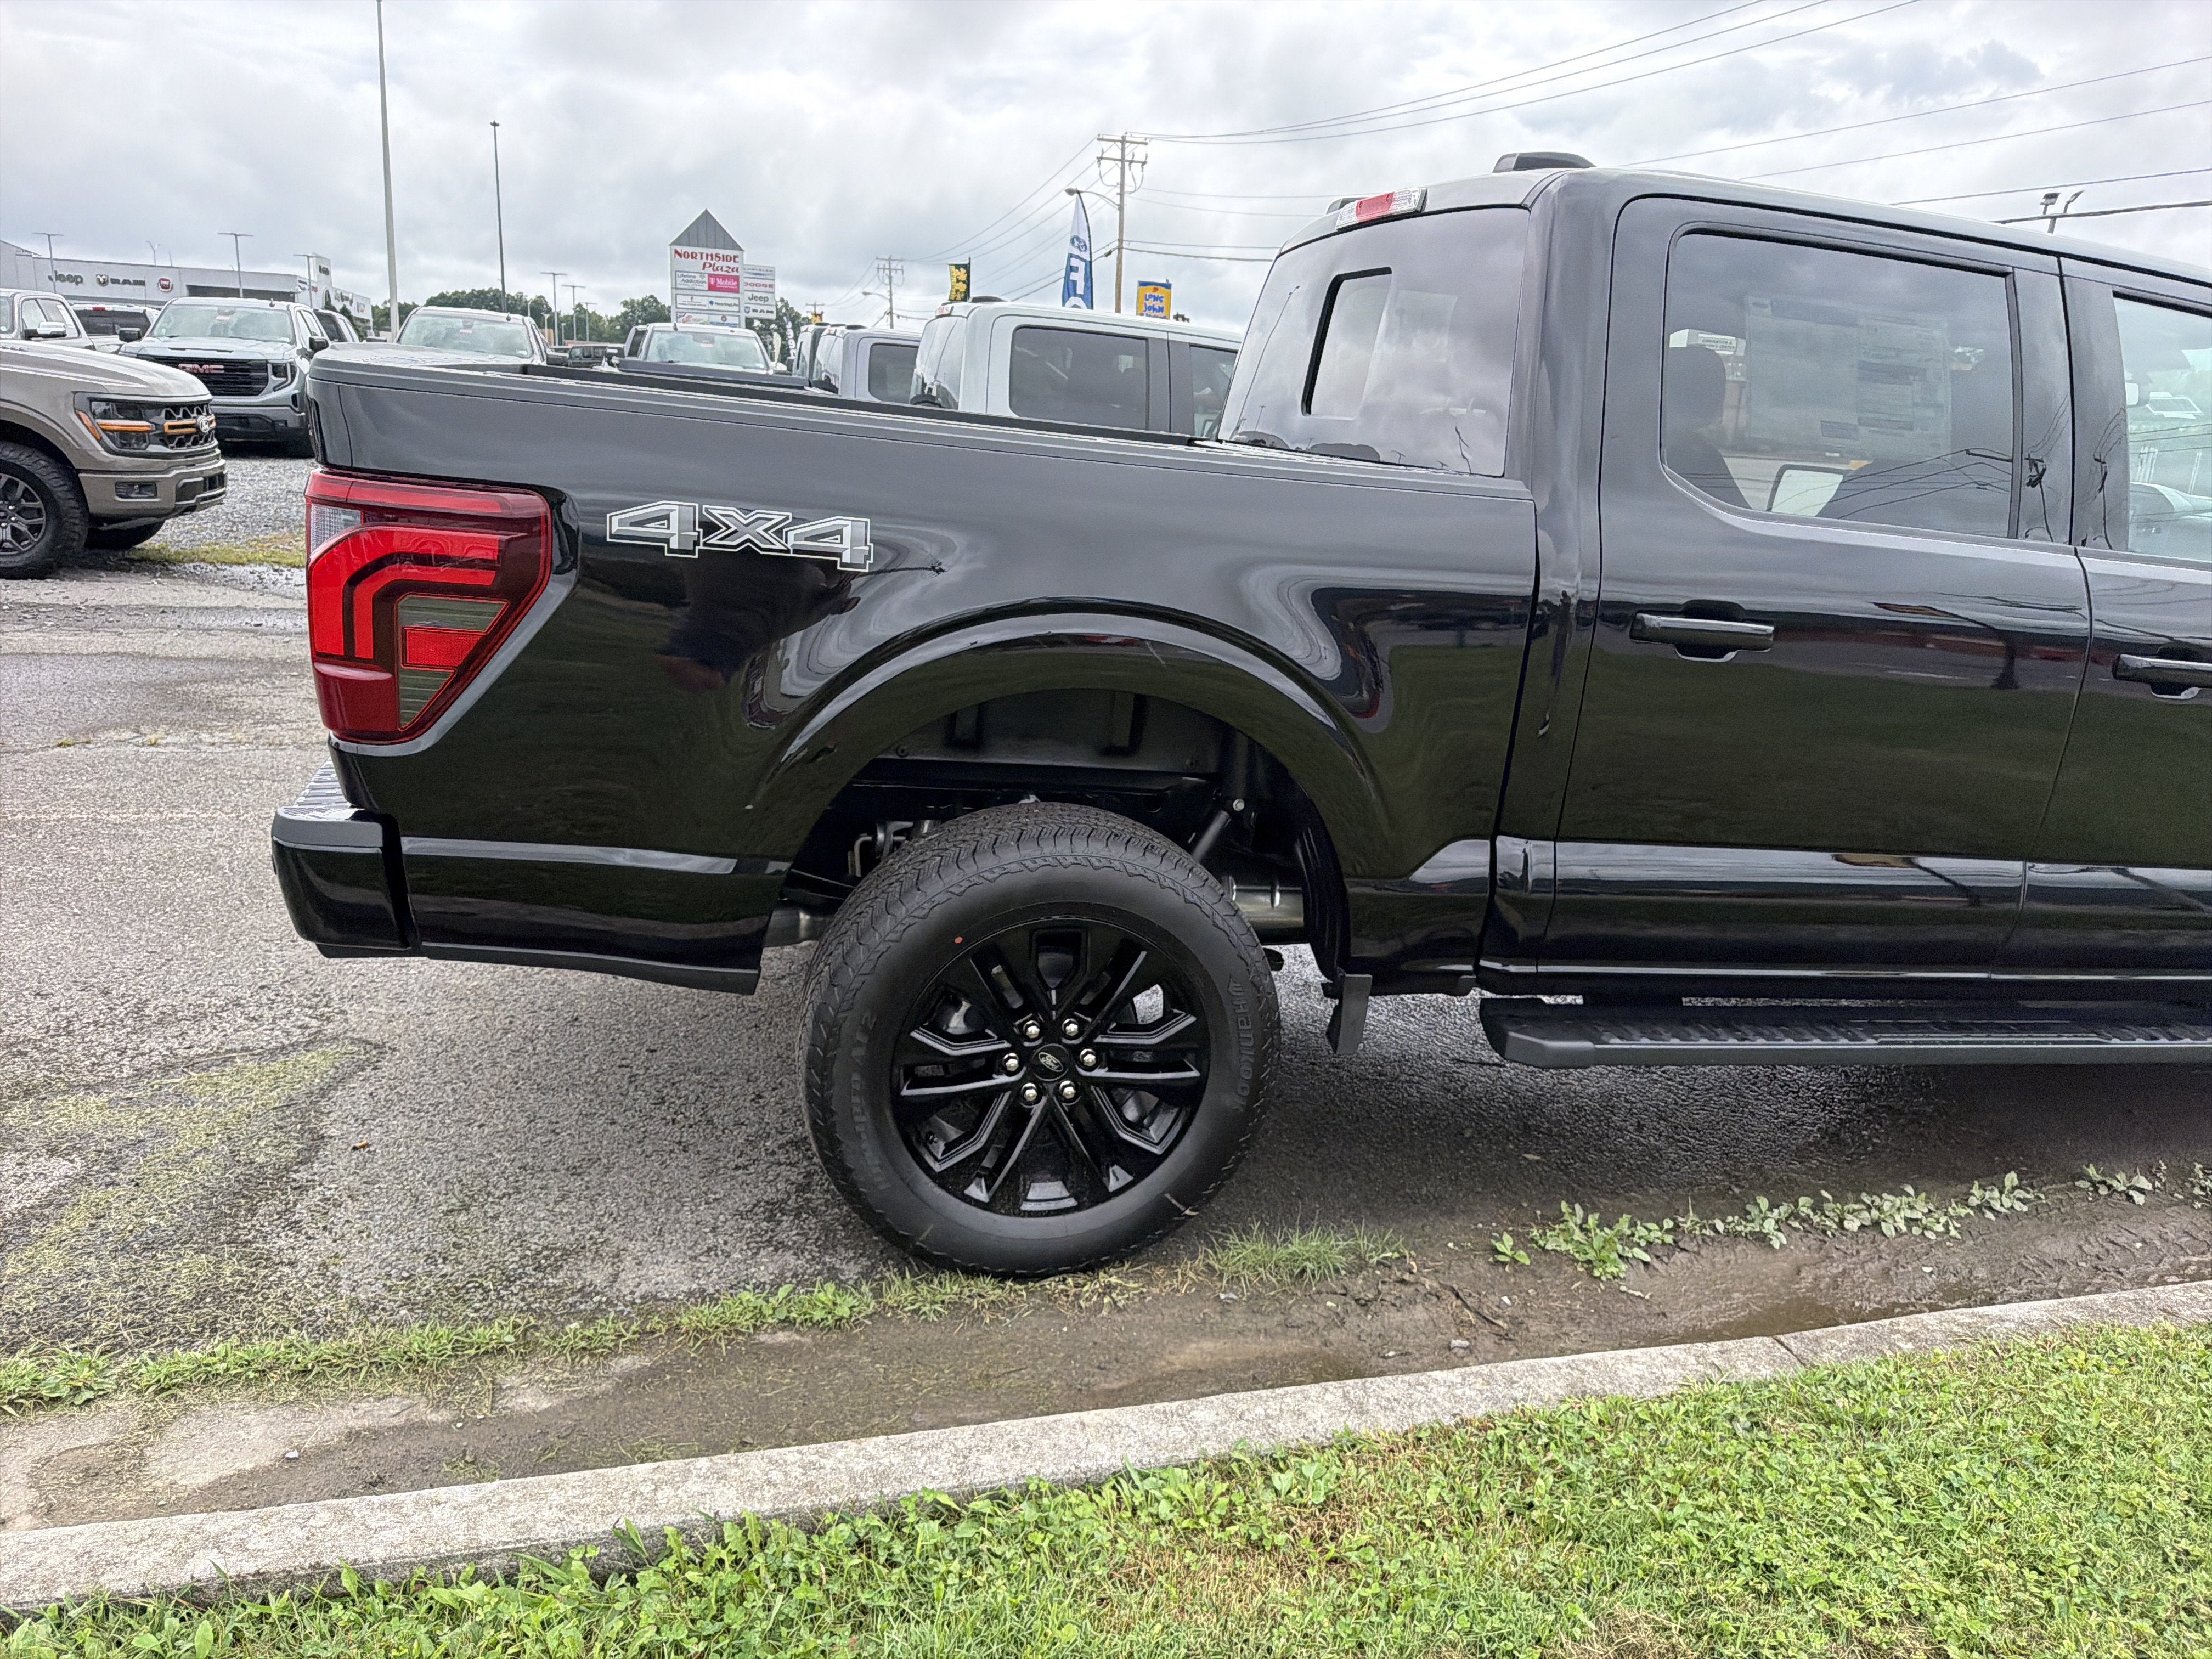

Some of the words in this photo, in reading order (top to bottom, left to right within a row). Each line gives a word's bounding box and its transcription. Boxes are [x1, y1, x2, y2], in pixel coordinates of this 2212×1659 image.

[674, 249, 739, 263] NORTHSIDE
[702, 262, 739, 273] Plaza
[748, 294, 769, 303] Jeep
[178, 363, 224, 373] GMC
[1233, 997, 1255, 1113] Hankook
[1041, 1054, 1062, 1071] Ford
